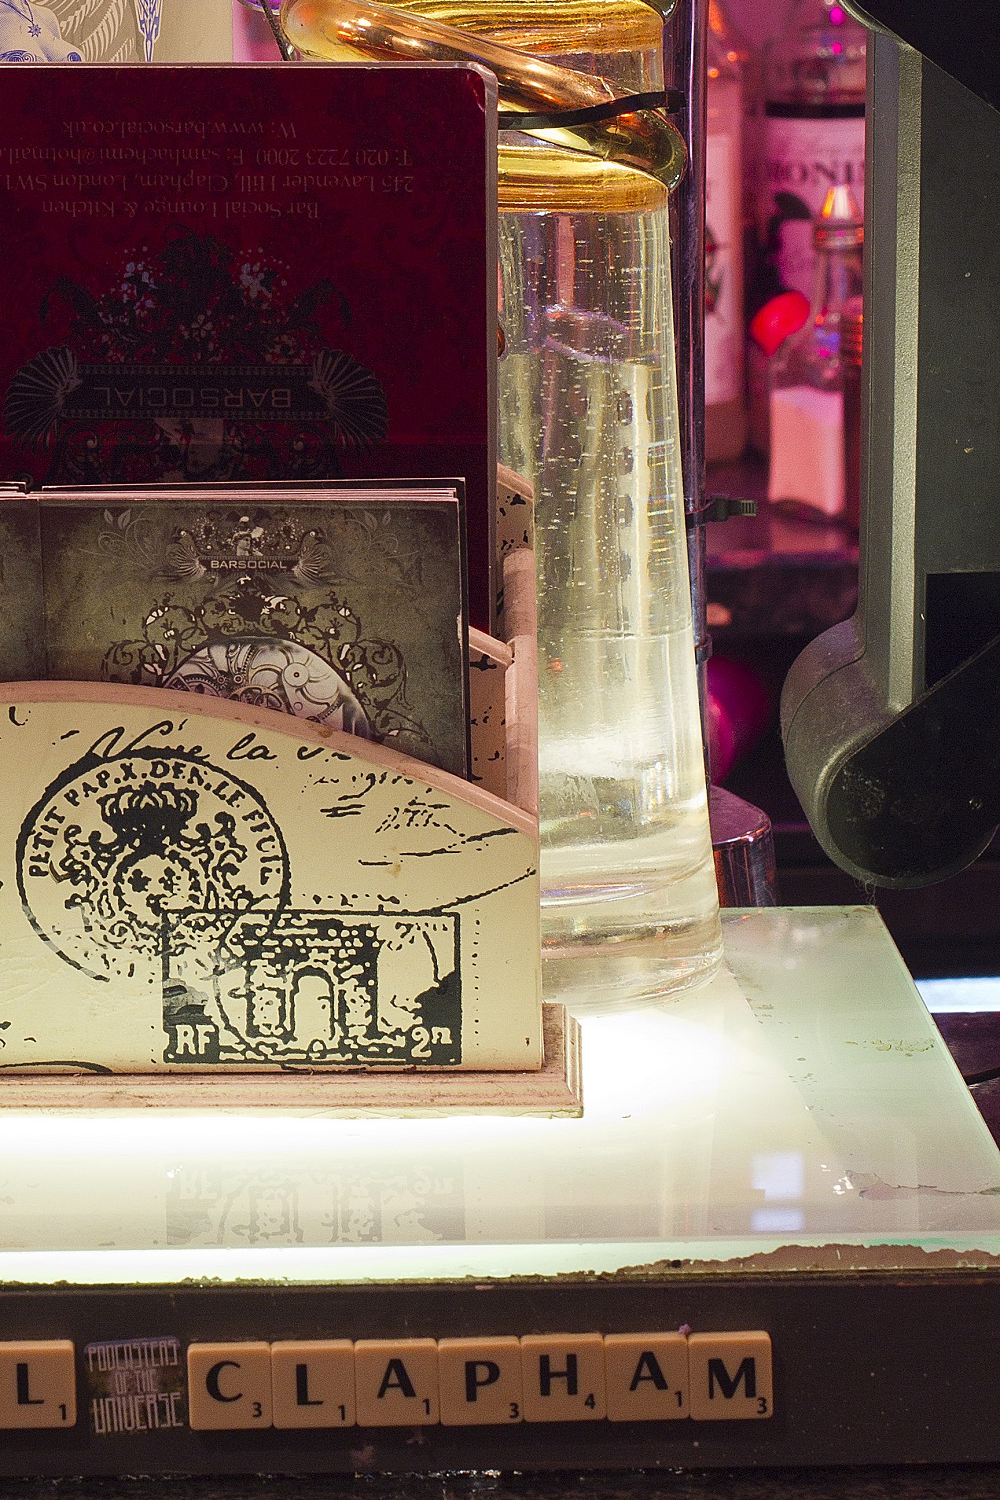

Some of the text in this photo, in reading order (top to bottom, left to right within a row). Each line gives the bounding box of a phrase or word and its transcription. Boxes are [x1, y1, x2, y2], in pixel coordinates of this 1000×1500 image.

[256, 148, 299, 166] 2000
[305, 148, 349, 166] 7223
[53, 174, 127, 193] London
[283, 174, 375, 193] Lavender
[381, 174, 415, 192] 245
[42, 201, 115, 219] Kitchen
[143, 198, 217, 218] Lounge
[224, 201, 281, 219] Social
[286, 201, 319, 219] Bar
[93, 386, 292, 408] BARSOCIAL
[209, 558, 288, 571] BARSOCIAL
[175, 1024, 215, 1055] RF
[87, 1340, 179, 1373] PODCASTERS
[205, 1351, 759, 1404] CLAPHAM
[92, 1391, 185, 1434] UNIVERSE
